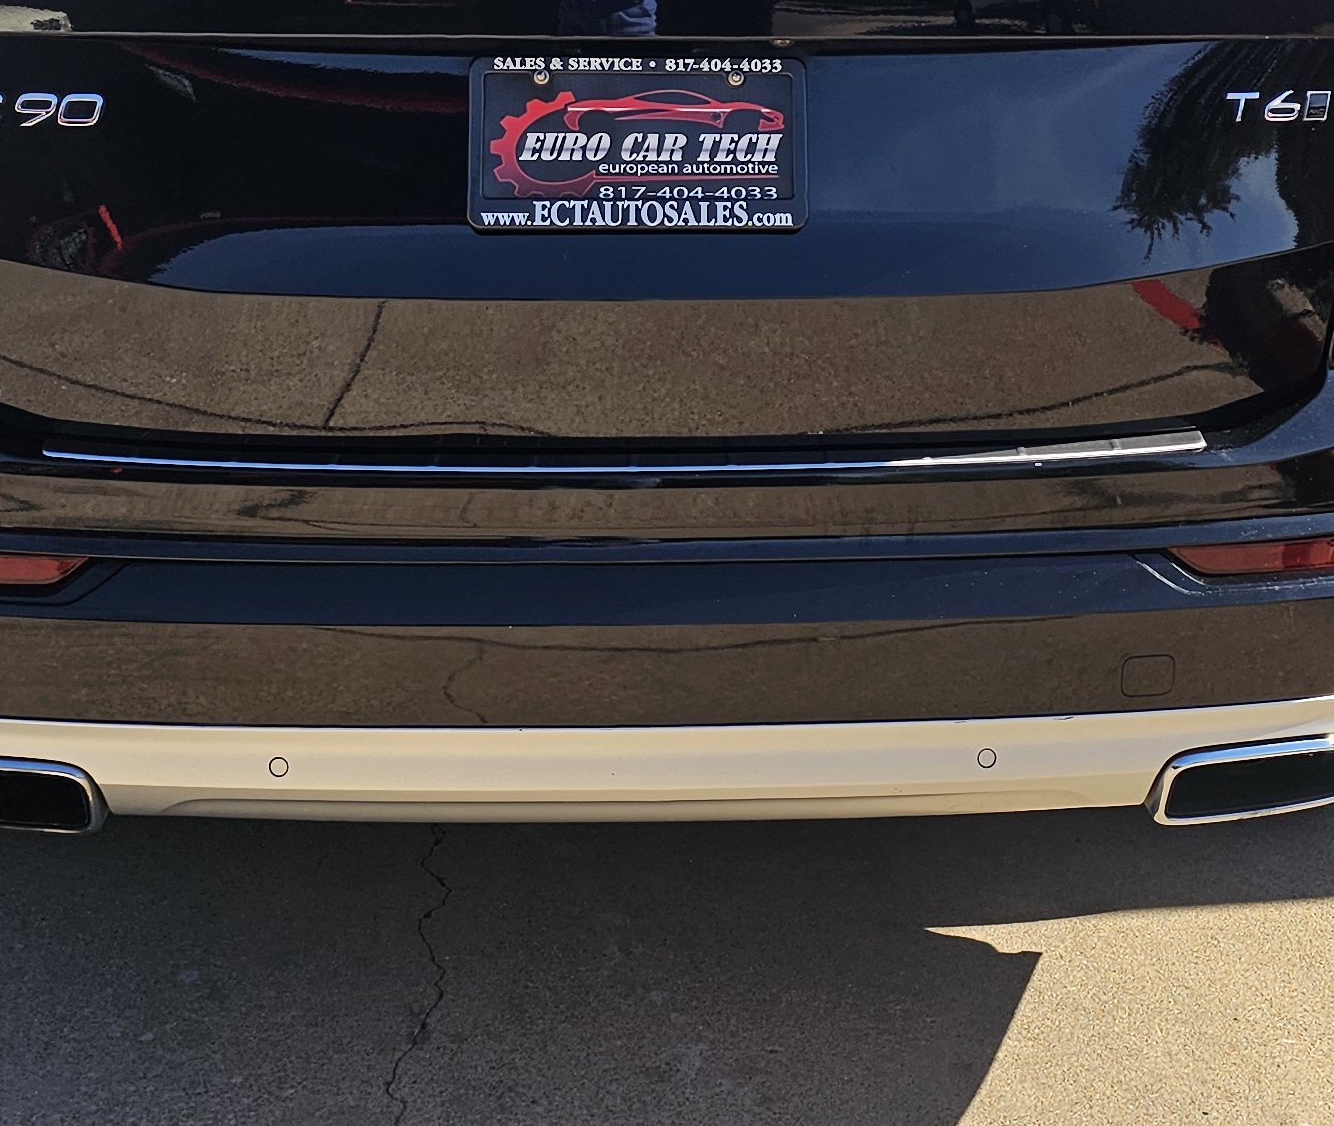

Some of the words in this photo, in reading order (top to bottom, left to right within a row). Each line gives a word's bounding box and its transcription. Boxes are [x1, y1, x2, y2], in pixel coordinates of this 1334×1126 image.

[493, 57, 546, 70] SALES
[549, 58, 564, 70] &
[568, 58, 643, 71] SERVICE
[665, 58, 783, 73] 817-404-4033
[518, 132, 612, 162] EURO
[620, 132, 688, 162] CAR
[696, 133, 784, 163] TECH
[598, 162, 679, 177] european
[682, 162, 780, 175] automotive
[598, 185, 779, 200] 817-404-4033
[480, 200, 795, 227] www.ECTAUTOSALES.com
